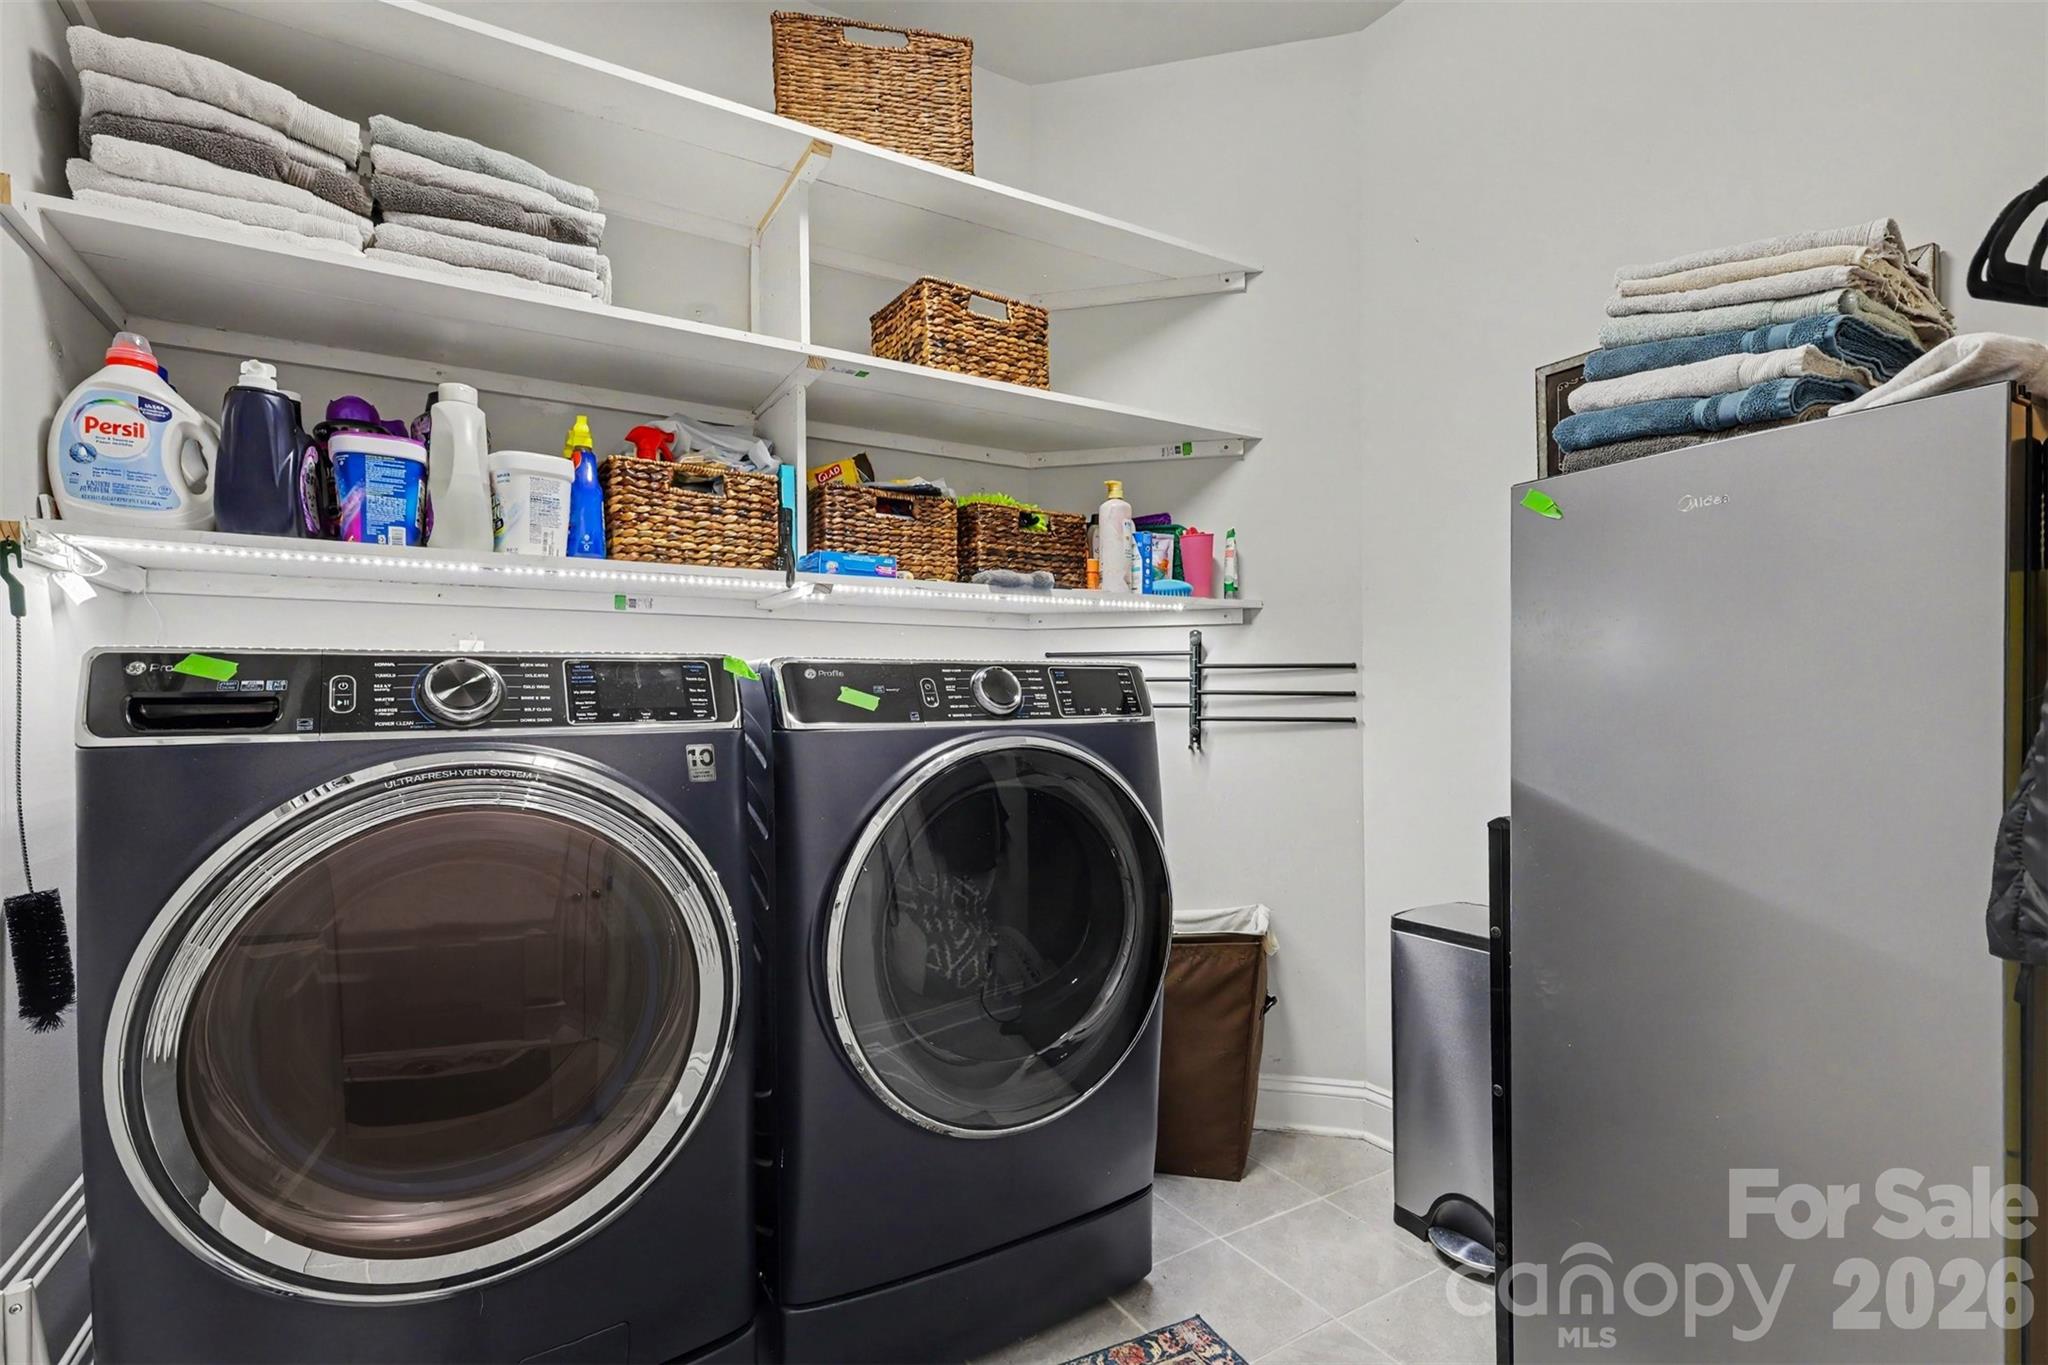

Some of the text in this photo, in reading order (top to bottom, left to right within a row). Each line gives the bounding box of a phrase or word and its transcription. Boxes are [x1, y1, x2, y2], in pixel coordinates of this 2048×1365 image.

[84, 415, 145, 438] Persil
[818, 465, 840, 483] GLAD
[384, 769, 458, 789] ULTRAFRESH
[460, 768, 491, 777] VENT
[489, 769, 532, 779] SYSTEM
